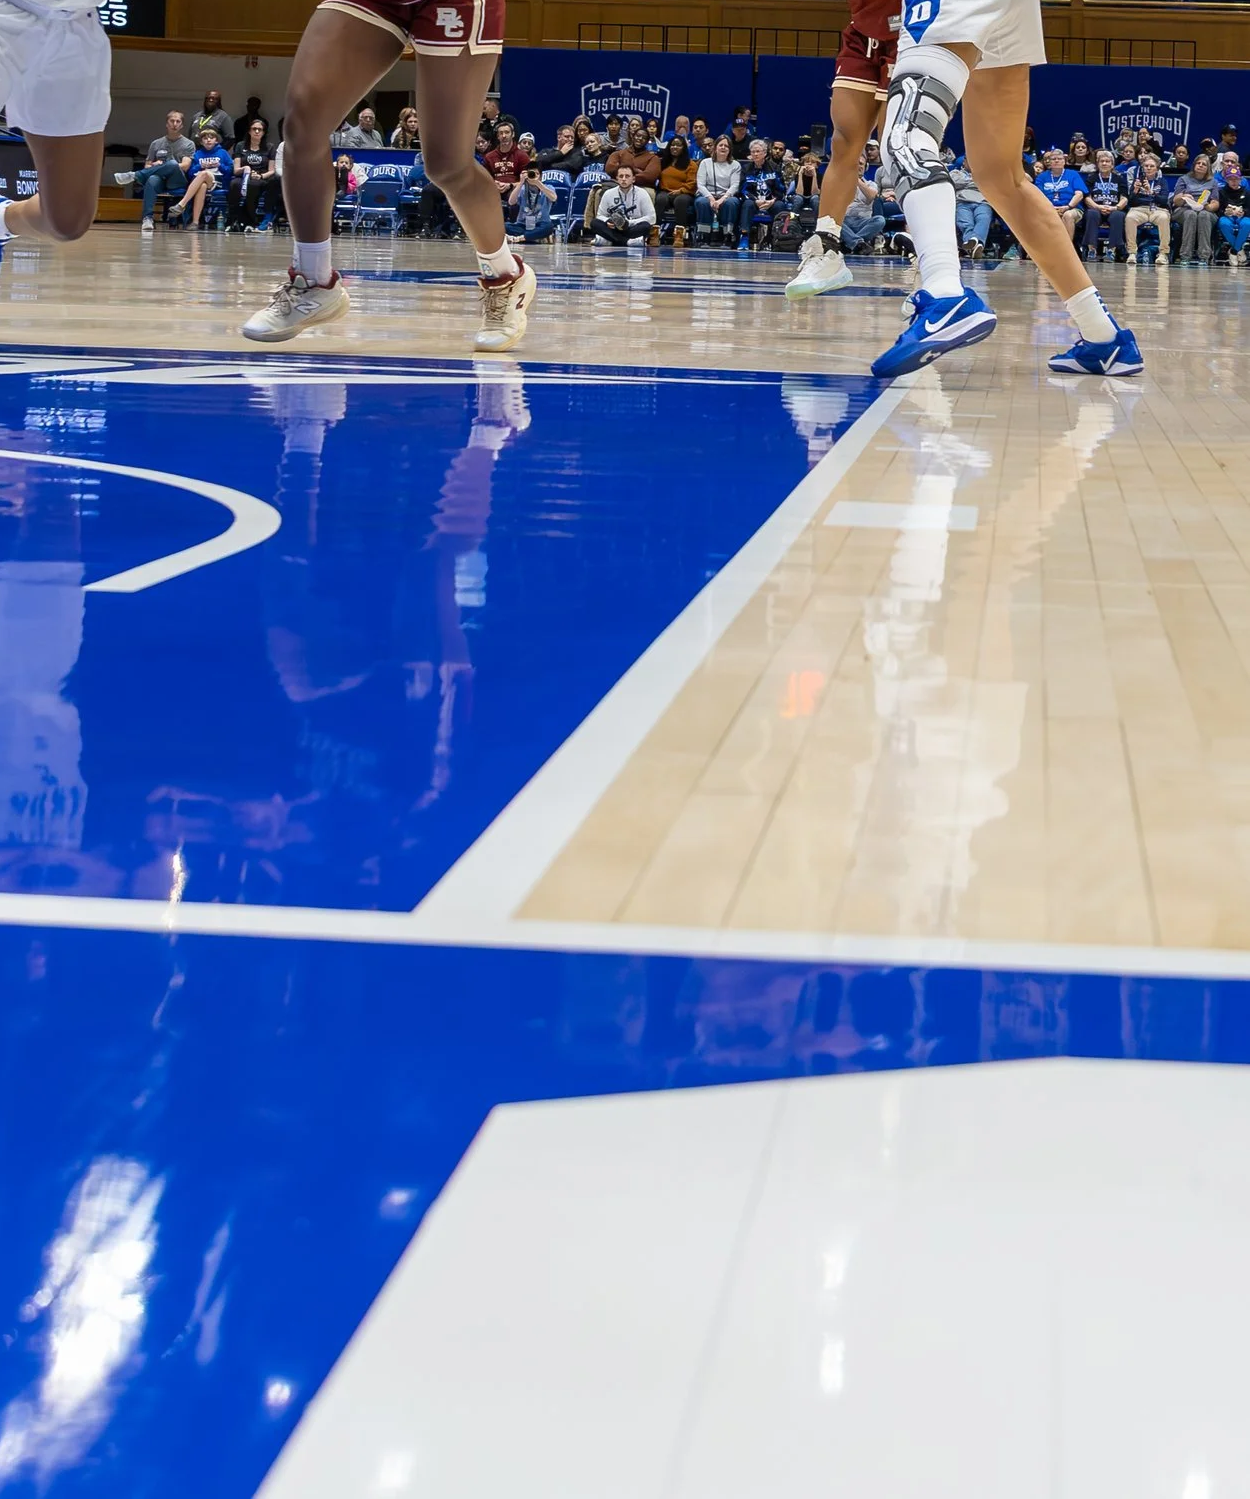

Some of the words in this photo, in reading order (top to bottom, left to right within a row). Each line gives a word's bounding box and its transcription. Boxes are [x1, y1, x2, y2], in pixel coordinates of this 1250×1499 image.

[436, 7, 464, 38] BC
[909, 0, 932, 24] D
[588, 97, 662, 118] SISTERHOOD
[1107, 114, 1182, 136] SISTERHOOD
[373, 167, 396, 177] DUKE
